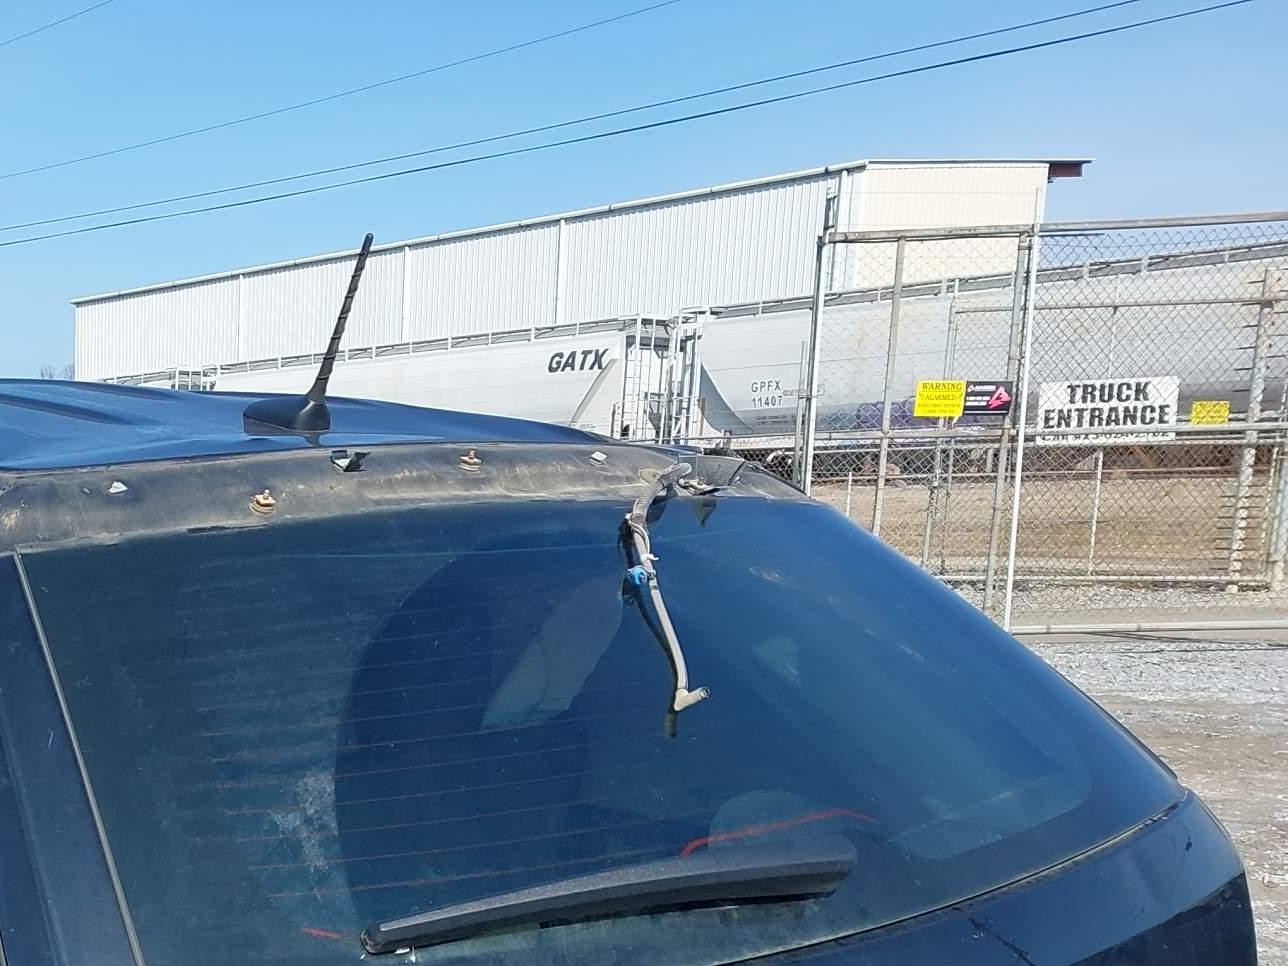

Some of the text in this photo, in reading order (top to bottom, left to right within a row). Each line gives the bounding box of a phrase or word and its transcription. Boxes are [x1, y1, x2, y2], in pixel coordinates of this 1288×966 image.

[548, 349, 610, 373] GATX
[751, 380, 781, 393] GPFX
[921, 382, 962, 391] WARNING
[1067, 381, 1152, 405] TRUCK
[752, 395, 782, 408] 11407
[1043, 404, 1171, 430] ENTRANCE
